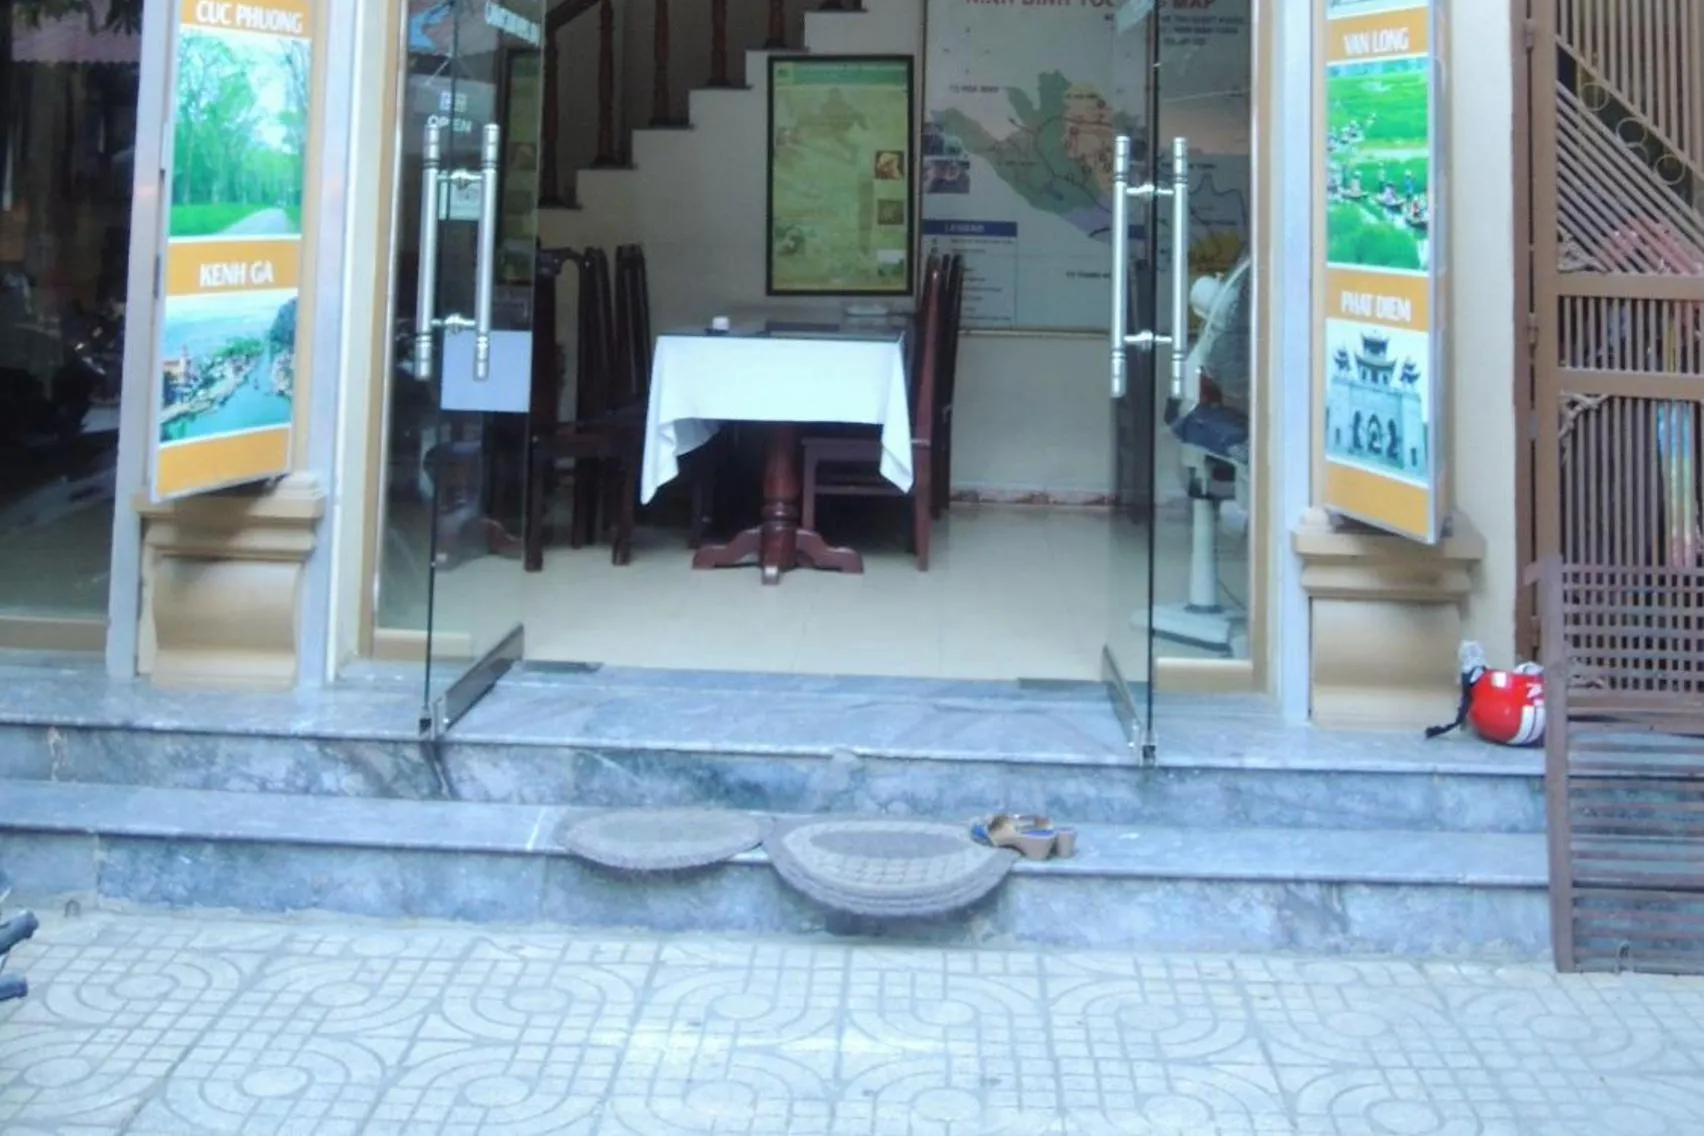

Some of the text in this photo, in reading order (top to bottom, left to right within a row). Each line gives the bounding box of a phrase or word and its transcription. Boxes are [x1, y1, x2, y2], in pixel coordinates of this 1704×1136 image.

[196, 0, 304, 34] CUC PHUONG
[1373, 26, 1409, 53] LONG
[427, 115, 472, 132] OPEN
[199, 259, 275, 288] KENH GA
